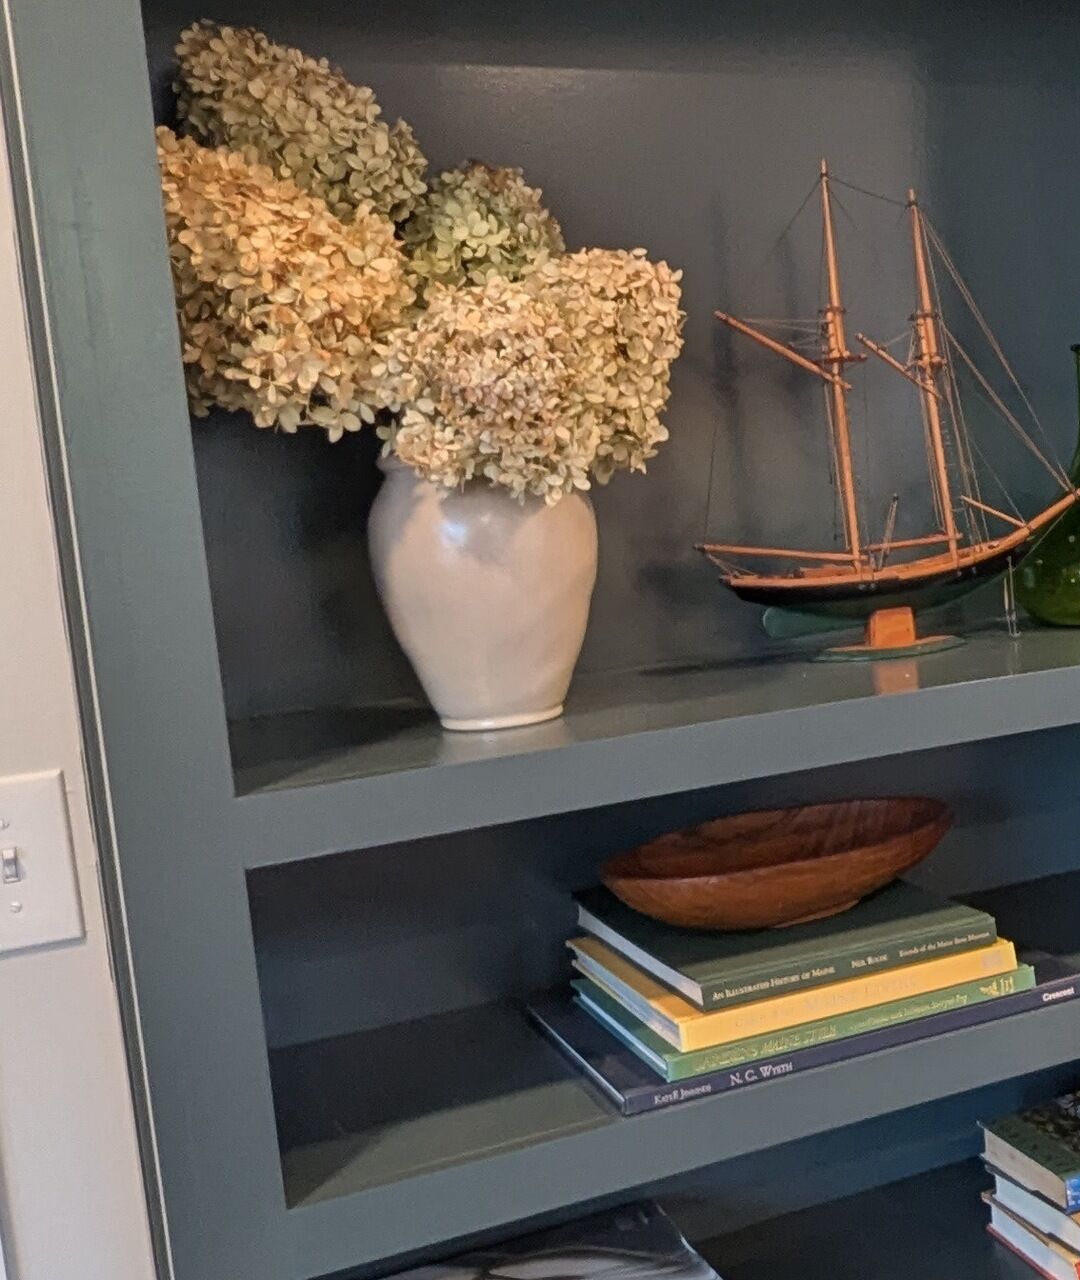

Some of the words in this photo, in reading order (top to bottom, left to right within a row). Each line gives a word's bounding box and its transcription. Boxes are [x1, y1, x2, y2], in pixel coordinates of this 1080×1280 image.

[729, 1072, 744, 1087] N.
[744, 1069, 758, 1083] C.
[759, 1061, 793, 1078] WYETH
